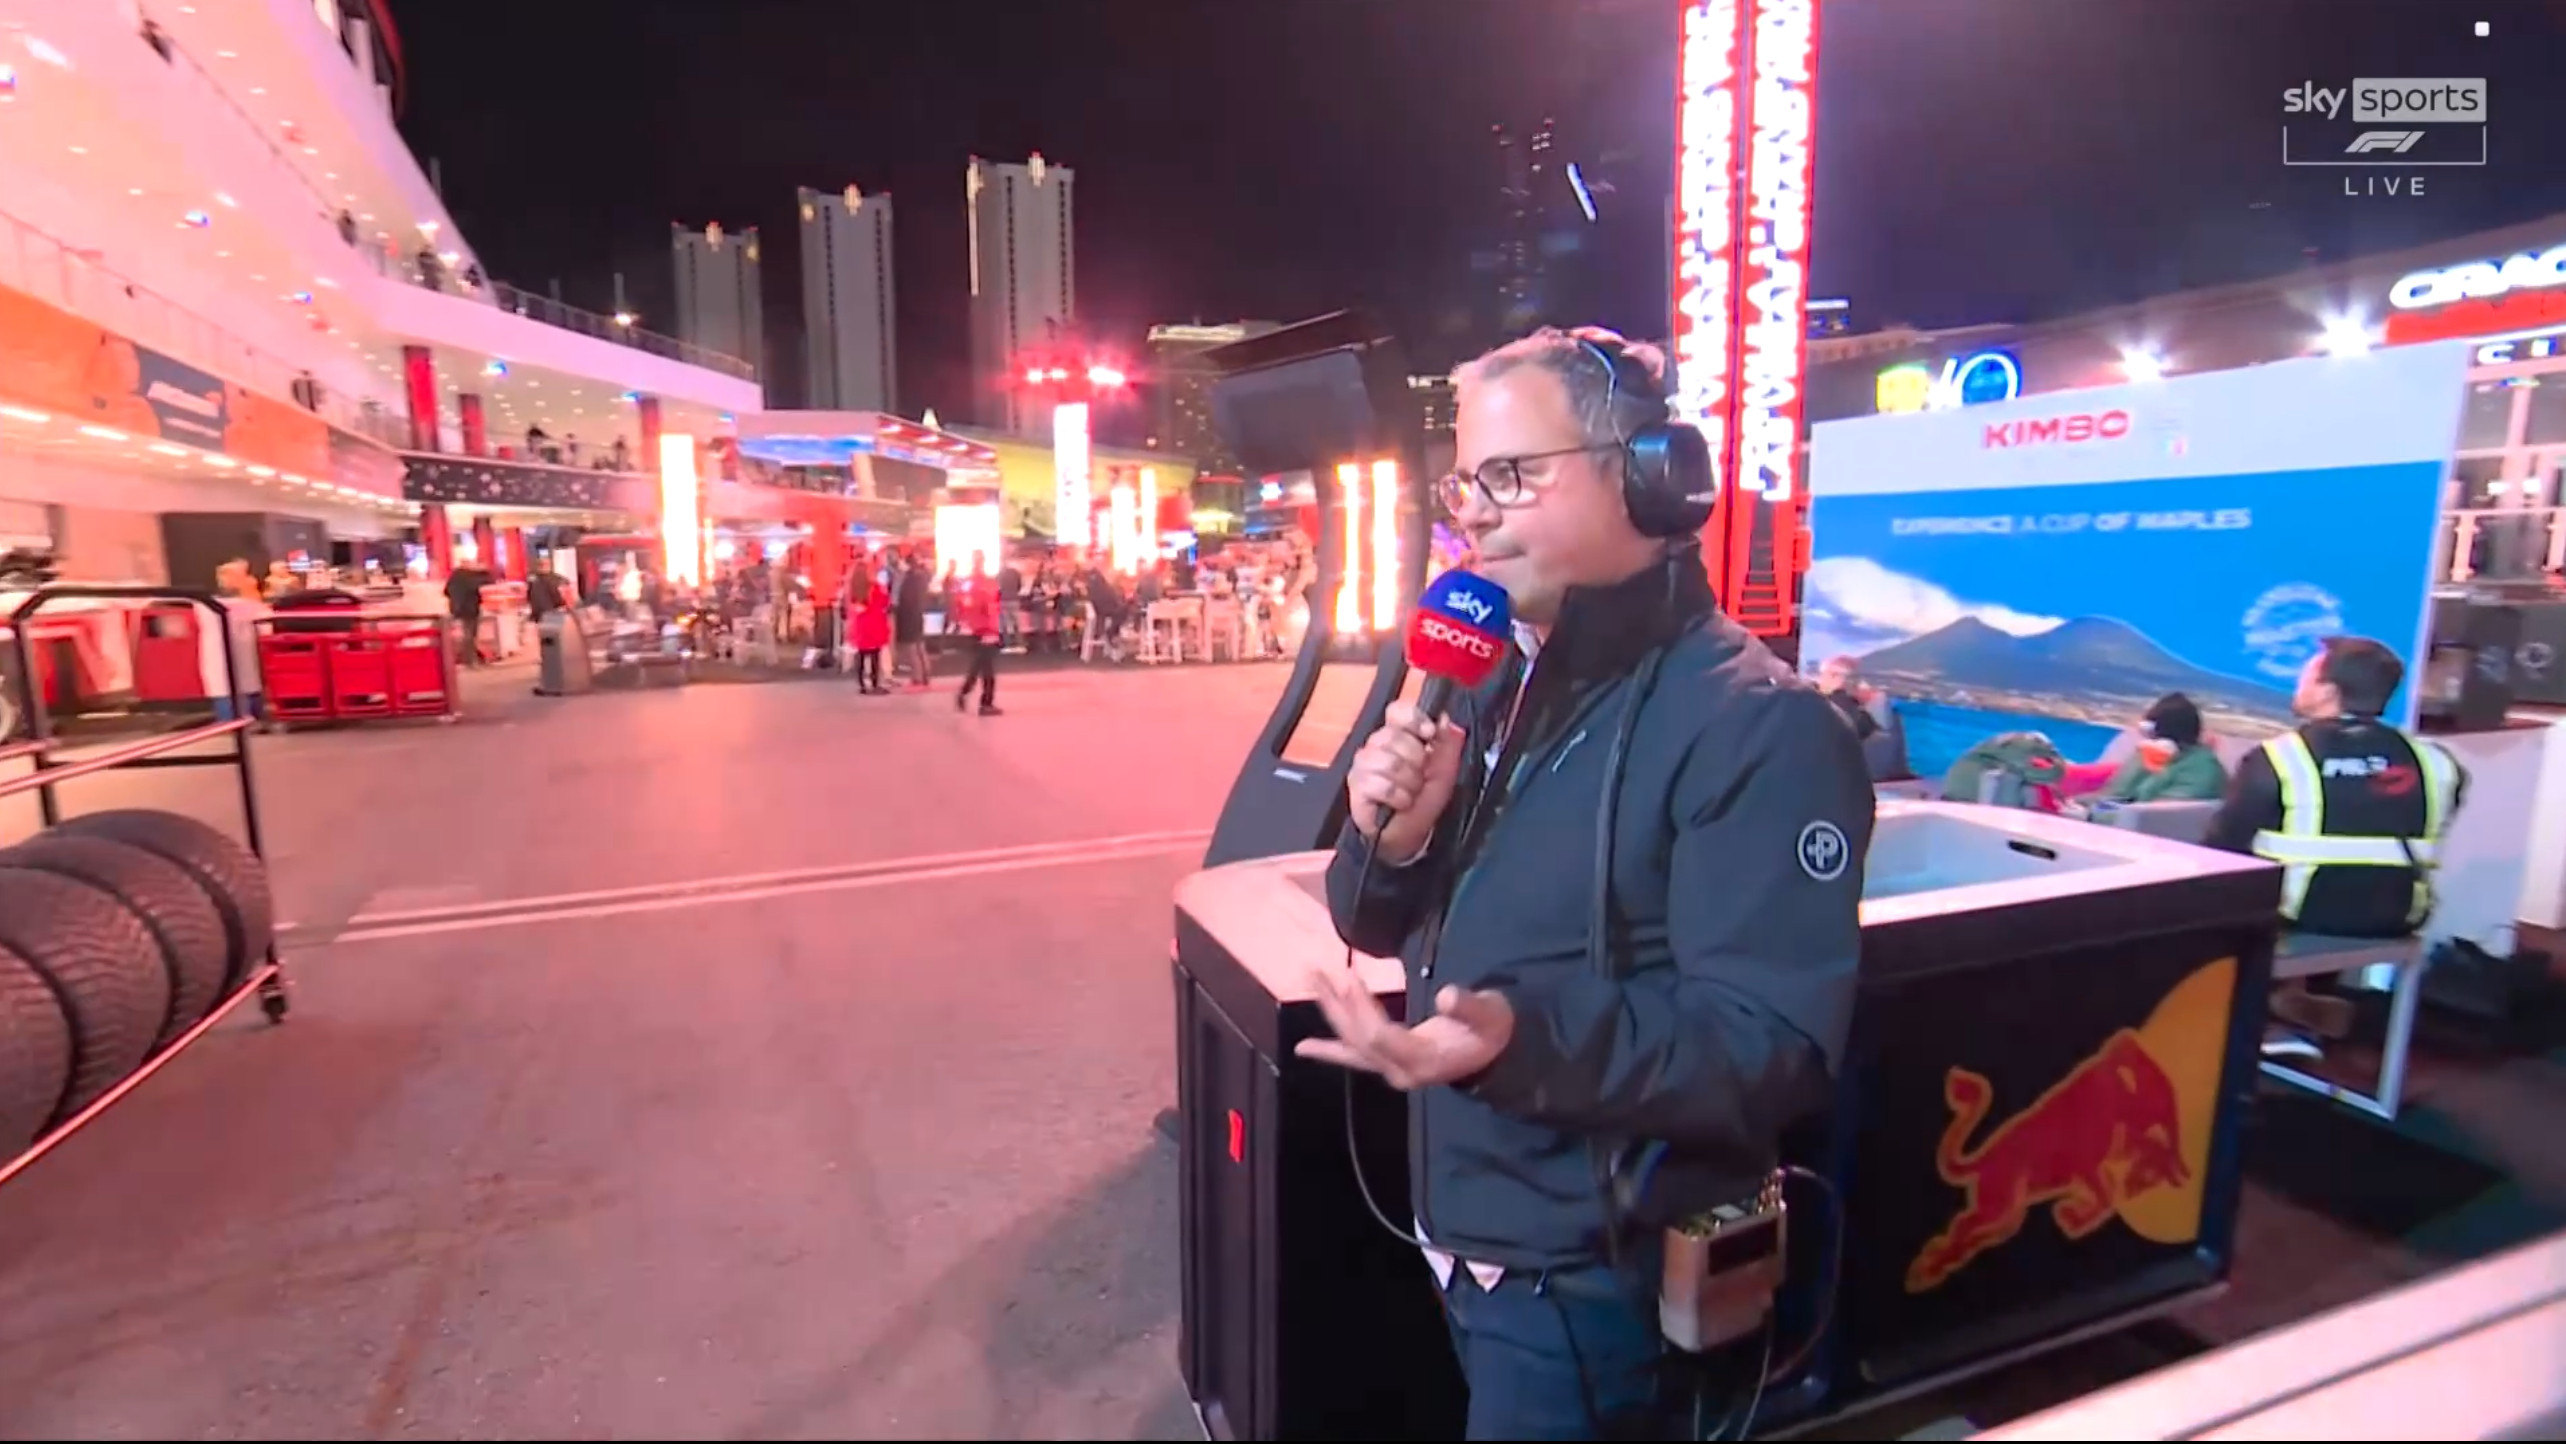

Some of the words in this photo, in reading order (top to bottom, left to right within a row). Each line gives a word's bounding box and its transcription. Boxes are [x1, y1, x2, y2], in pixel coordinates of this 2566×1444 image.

[1983, 410, 2130, 450] KIMBO
[2093, 510, 2133, 532] OF
[1446, 590, 1493, 624] sky
[1421, 619, 1494, 658] sports
